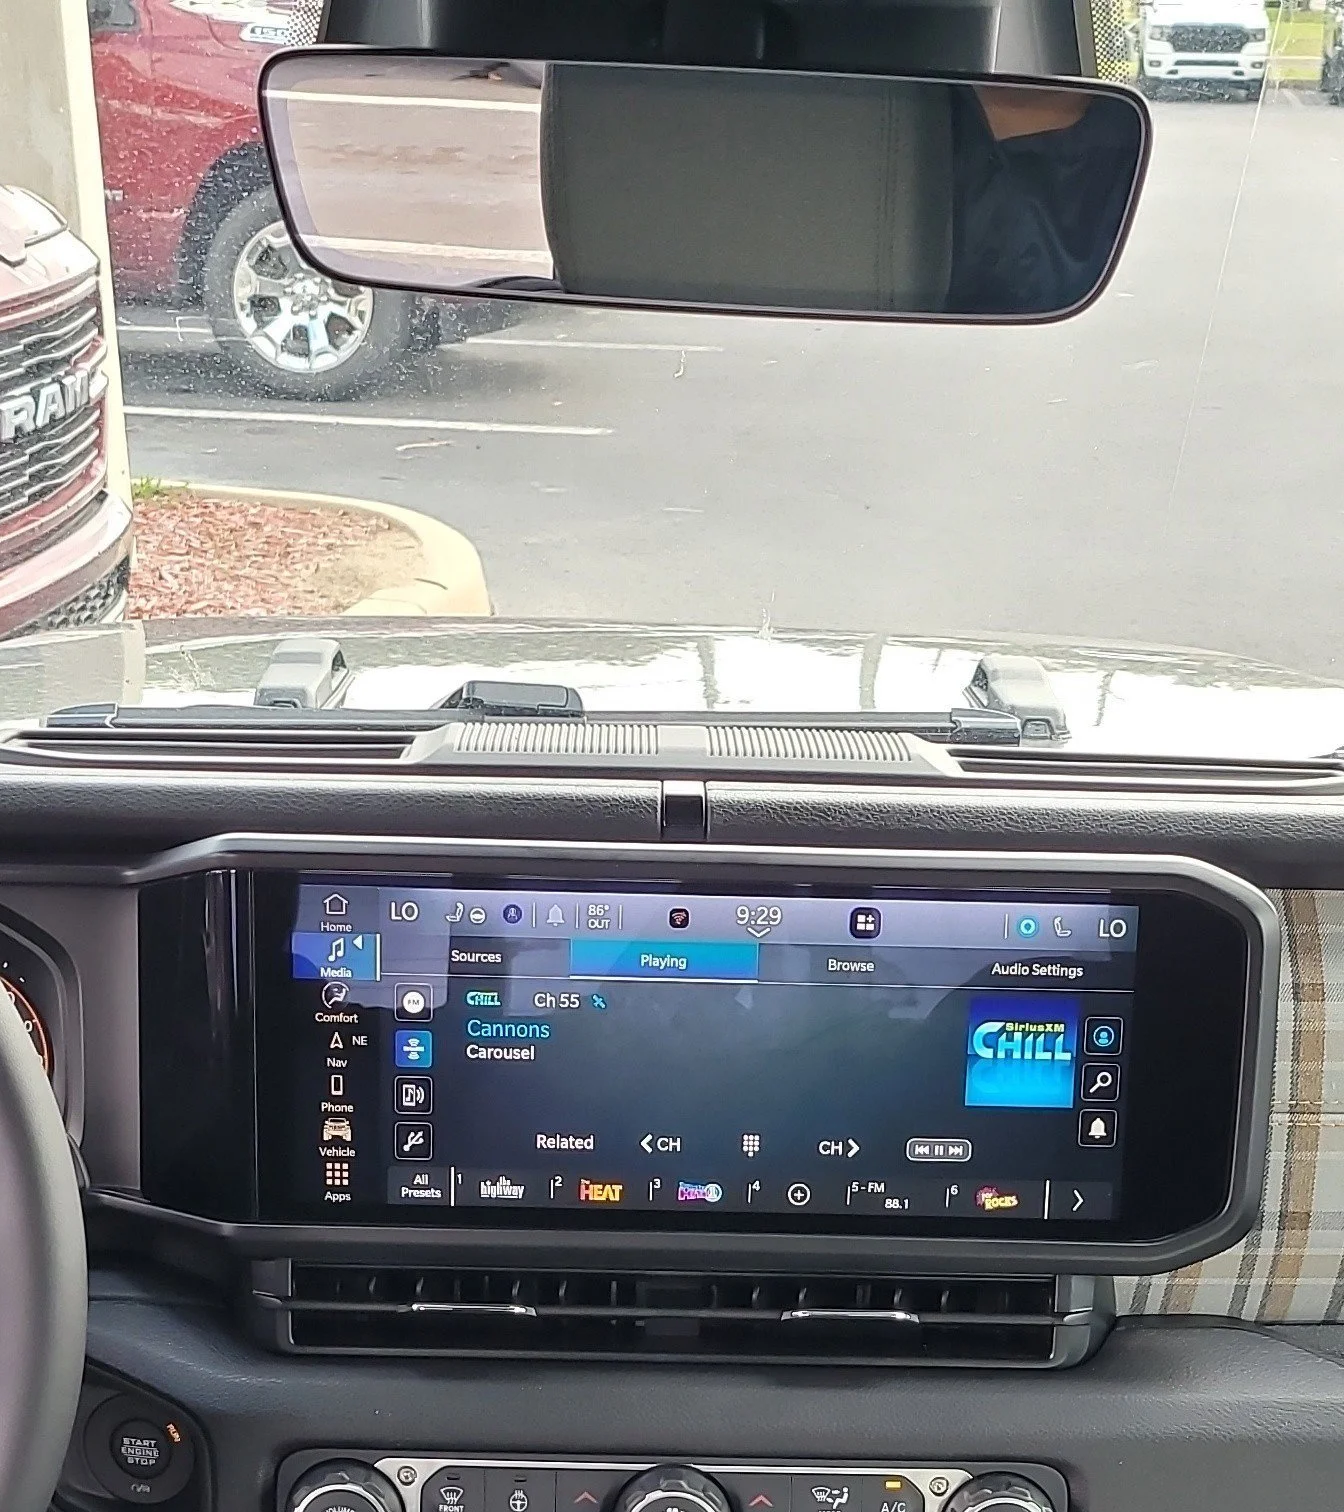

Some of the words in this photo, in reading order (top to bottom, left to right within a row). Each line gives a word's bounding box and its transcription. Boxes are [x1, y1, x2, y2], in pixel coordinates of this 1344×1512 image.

[390, 901, 419, 921] LO
[588, 904, 610, 916] 86°
[735, 905, 783, 926] 9:29
[320, 921, 353, 933] Home
[588, 918, 610, 930] OUT
[1099, 918, 1127, 938] LO
[450, 950, 502, 963] Sources
[640, 954, 688, 971] Playing
[827, 958, 875, 972] Browse
[991, 962, 1030, 976] Audio
[1031, 963, 1084, 979] Settings
[320, 967, 353, 979] Media
[466, 991, 502, 1006] CHILL
[533, 992, 556, 1009] Ch
[559, 993, 580, 1009] 55
[315, 1012, 359, 1024] Comfort
[466, 1019, 552, 1039] Cannons
[1005, 1022, 1065, 1033] SiriusXM
[351, 1035, 369, 1047] NE
[972, 1022, 1072, 1061] CHILL
[466, 1044, 535, 1061] Carousel
[326, 1057, 348, 1068] Nav
[320, 1102, 354, 1113] Phone
[536, 1134, 594, 1150] Related
[656, 1138, 681, 1152] CH
[818, 1140, 843, 1155] CH
[319, 1146, 356, 1158] Vehicle
[413, 1173, 429, 1185] All
[554, 1176, 563, 1187] 2
[653, 1178, 661, 1189] 3
[752, 1180, 761, 1191] 4
[950, 1184, 958, 1195] 6
[324, 1191, 352, 1203] Apps
[401, 1187, 442, 1199] Presets
[580, 1183, 623, 1202] HEAT
[884, 1197, 909, 1209] 88.1
[122, 1437, 157, 1448] START
[121, 1446, 160, 1458] ENGINE
[127, 1456, 156, 1466] STOP
